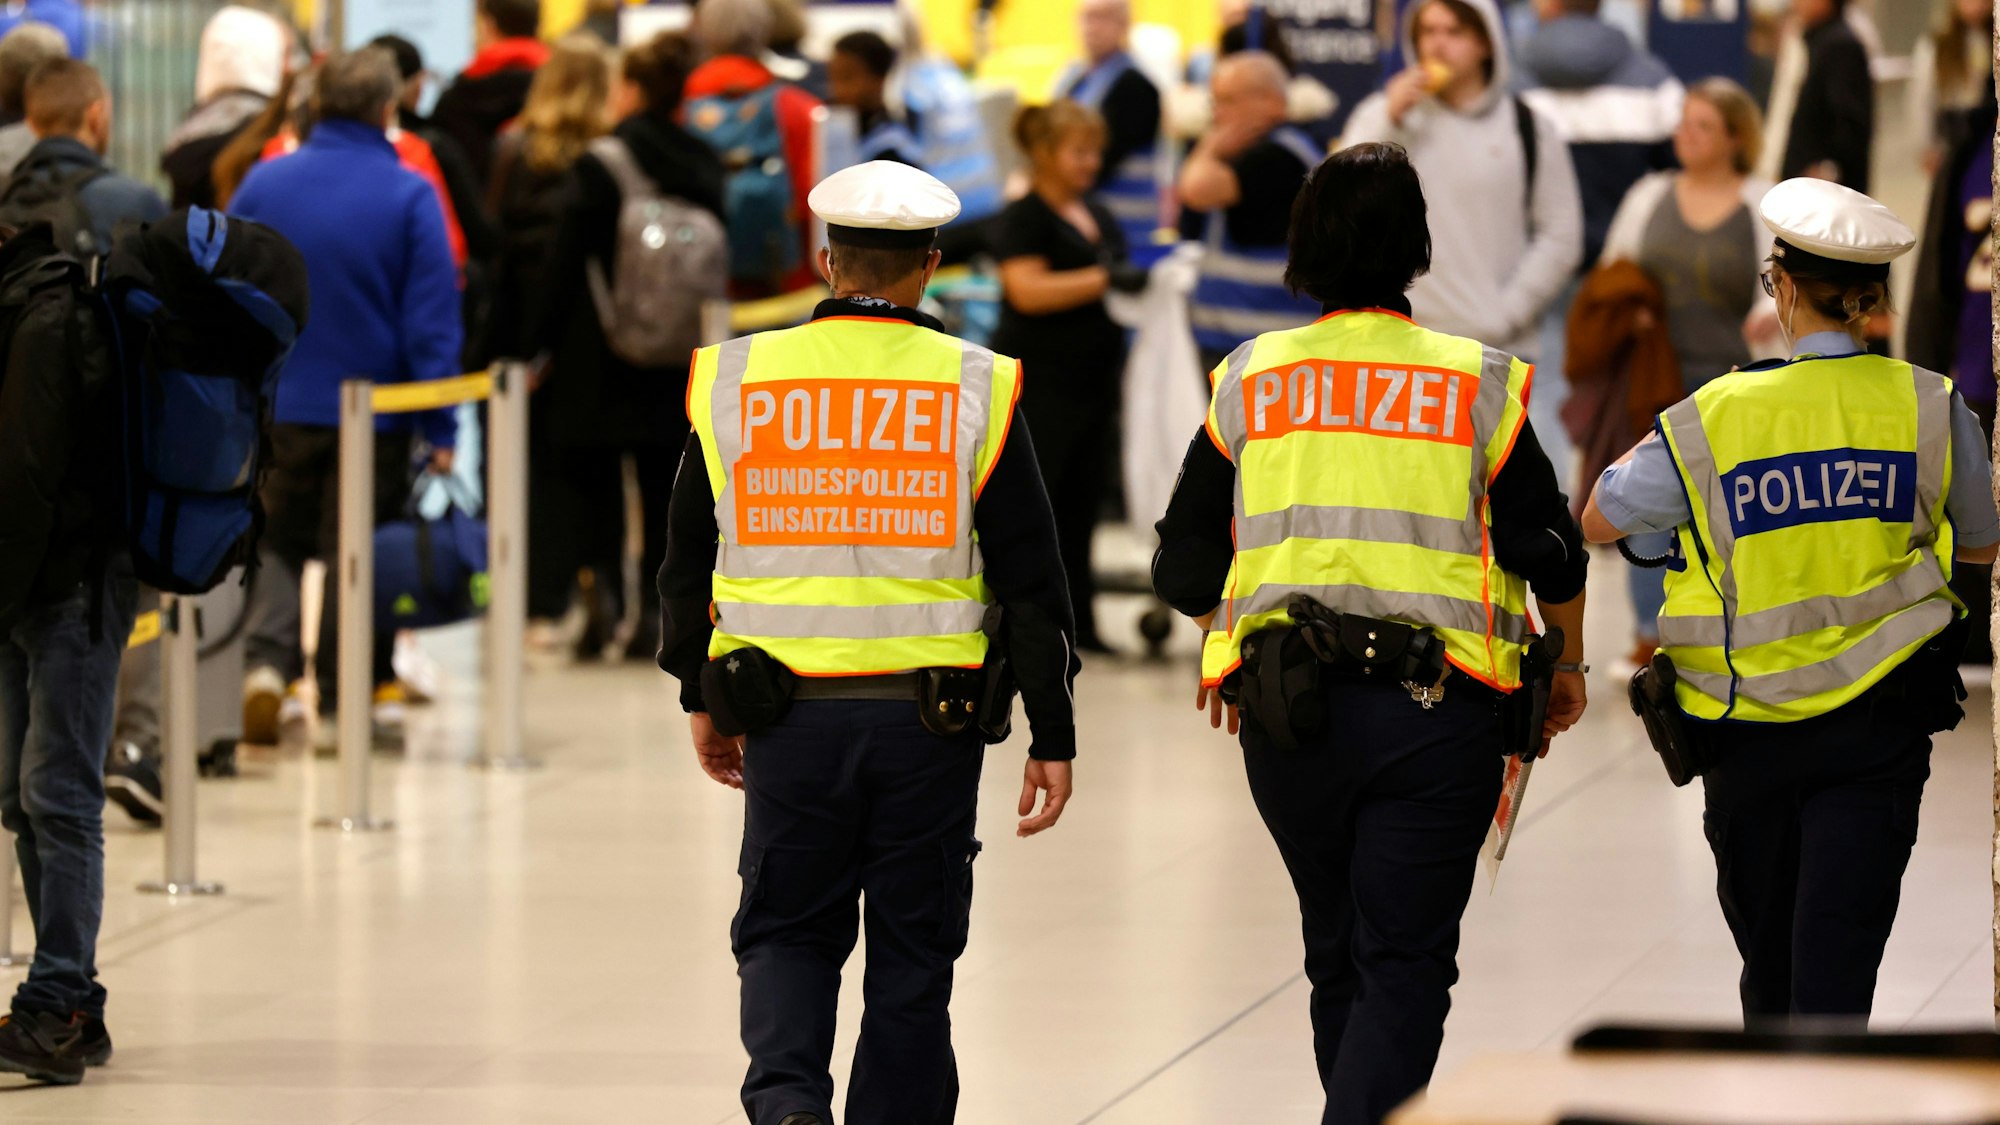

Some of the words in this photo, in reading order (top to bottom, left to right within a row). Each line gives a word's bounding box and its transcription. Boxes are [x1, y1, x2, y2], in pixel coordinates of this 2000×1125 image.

[742, 388, 953, 453] POLIZEI
[1254, 365, 1460, 437] POLIZEI
[745, 467, 948, 498] BUNDESPOLIZEI
[1734, 460, 1897, 522] POLIZEI
[746, 506, 946, 536] EINSATZLEITUNG
